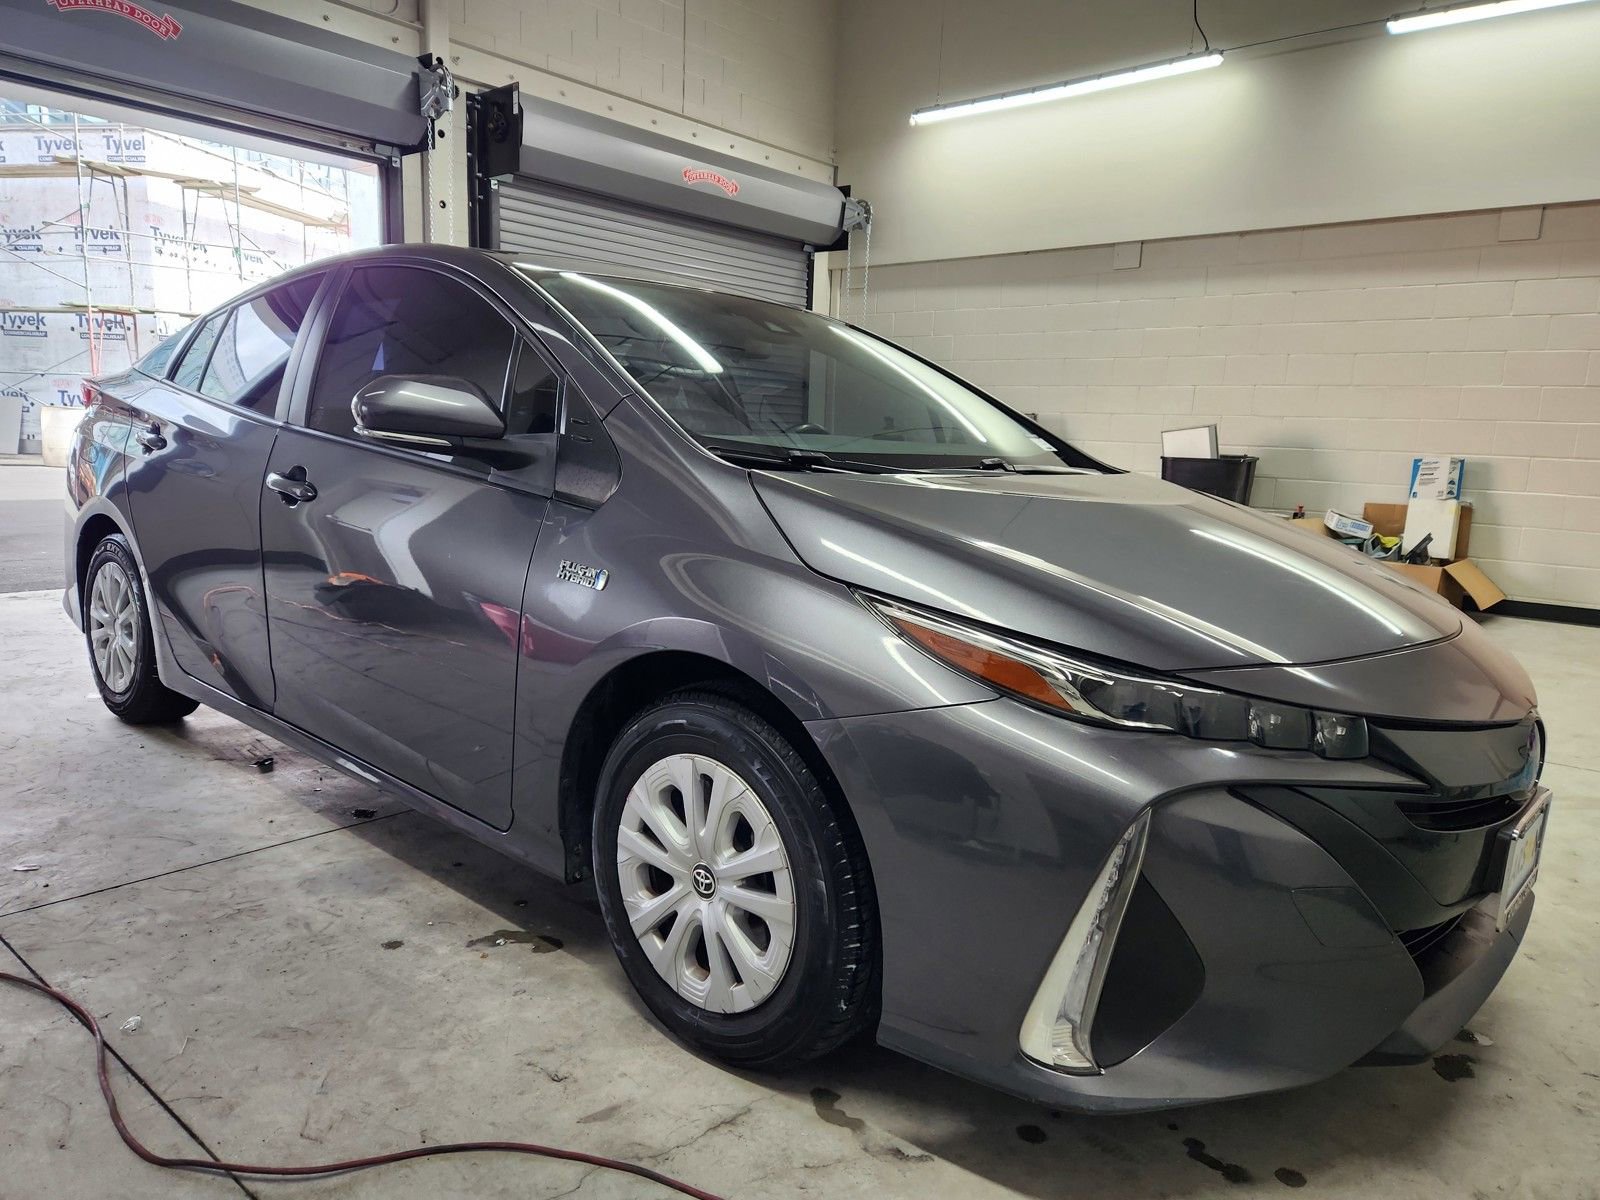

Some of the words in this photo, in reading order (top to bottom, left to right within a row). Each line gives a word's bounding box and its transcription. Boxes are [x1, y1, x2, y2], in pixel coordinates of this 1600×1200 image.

[134, 10, 167, 35] DOOR
[2, 225, 42, 243] yvek
[0, 311, 47, 328] Tyvek
[557, 570, 594, 588] HYBRID
